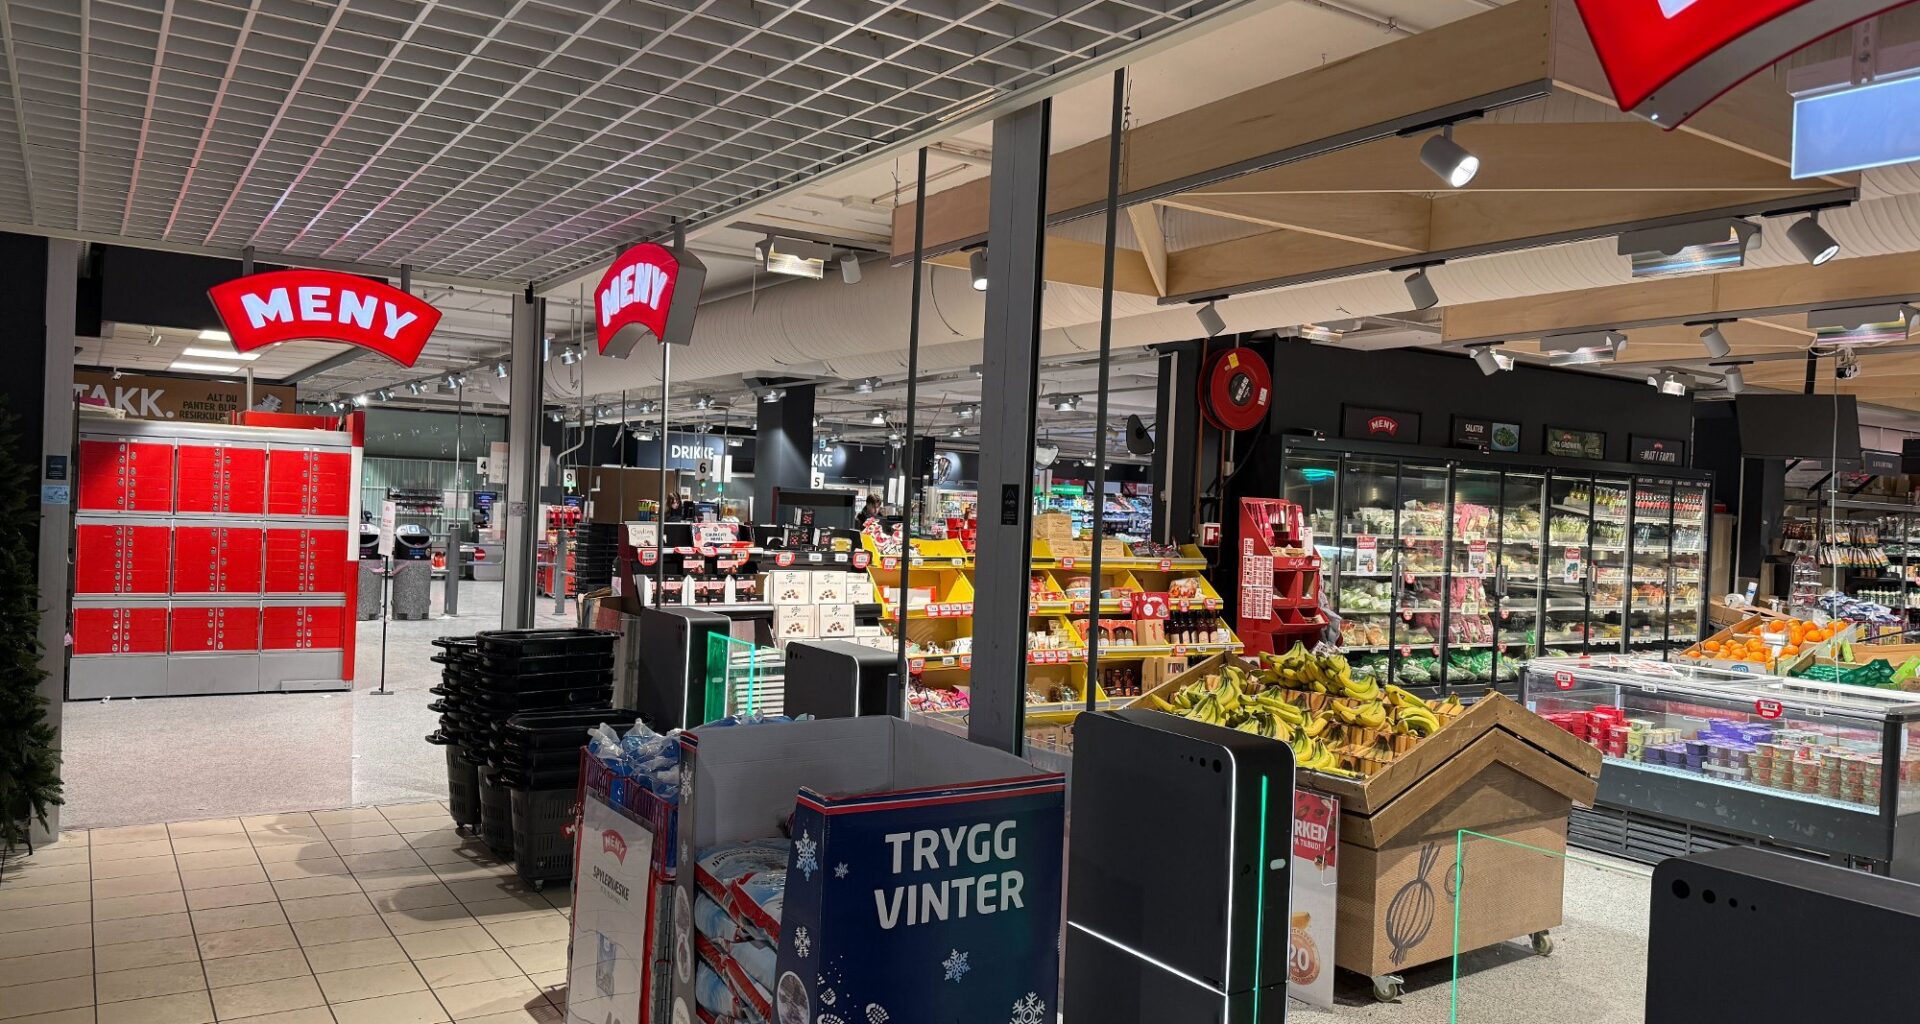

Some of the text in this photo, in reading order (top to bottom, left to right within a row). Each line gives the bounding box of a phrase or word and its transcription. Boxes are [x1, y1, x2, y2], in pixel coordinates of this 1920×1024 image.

[601, 262, 668, 327] MENY
[240, 286, 418, 339] MENY
[207, 393, 238, 403] ALT DU
[182, 400, 216, 411] PANTER
[1371, 419, 1395, 431] MENY
[1465, 423, 1484, 433] SALATER
[671, 444, 714, 459] DRIKKE
[480, 461, 487, 470] 4
[699, 462, 707, 474] 6
[566, 473, 573, 483] 9
[814, 476, 821, 488] 5
[604, 835, 625, 856] MENY
[885, 820, 1017, 874] TRYGG
[874, 870, 1025, 930] VINTER
